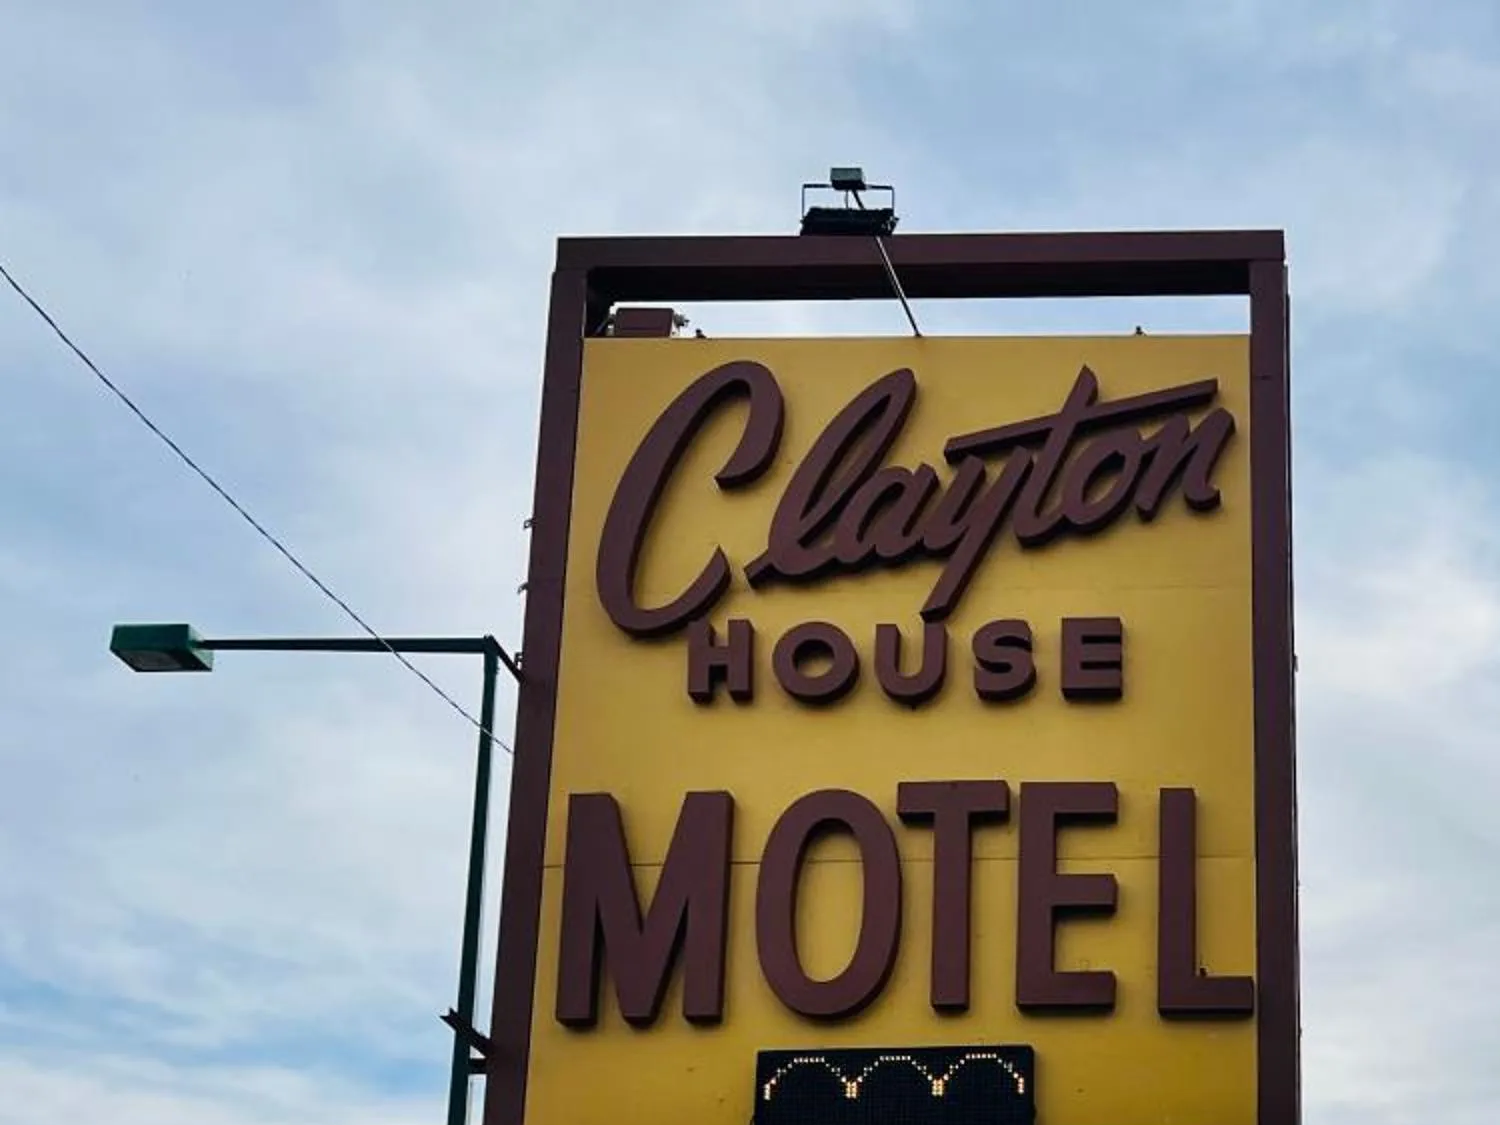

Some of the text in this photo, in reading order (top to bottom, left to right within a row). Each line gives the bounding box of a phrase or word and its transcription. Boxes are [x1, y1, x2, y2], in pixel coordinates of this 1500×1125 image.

[596, 360, 1235, 638] Clayton
[687, 616, 1123, 706] HOUSE
[555, 780, 1255, 1030] MOTEL
